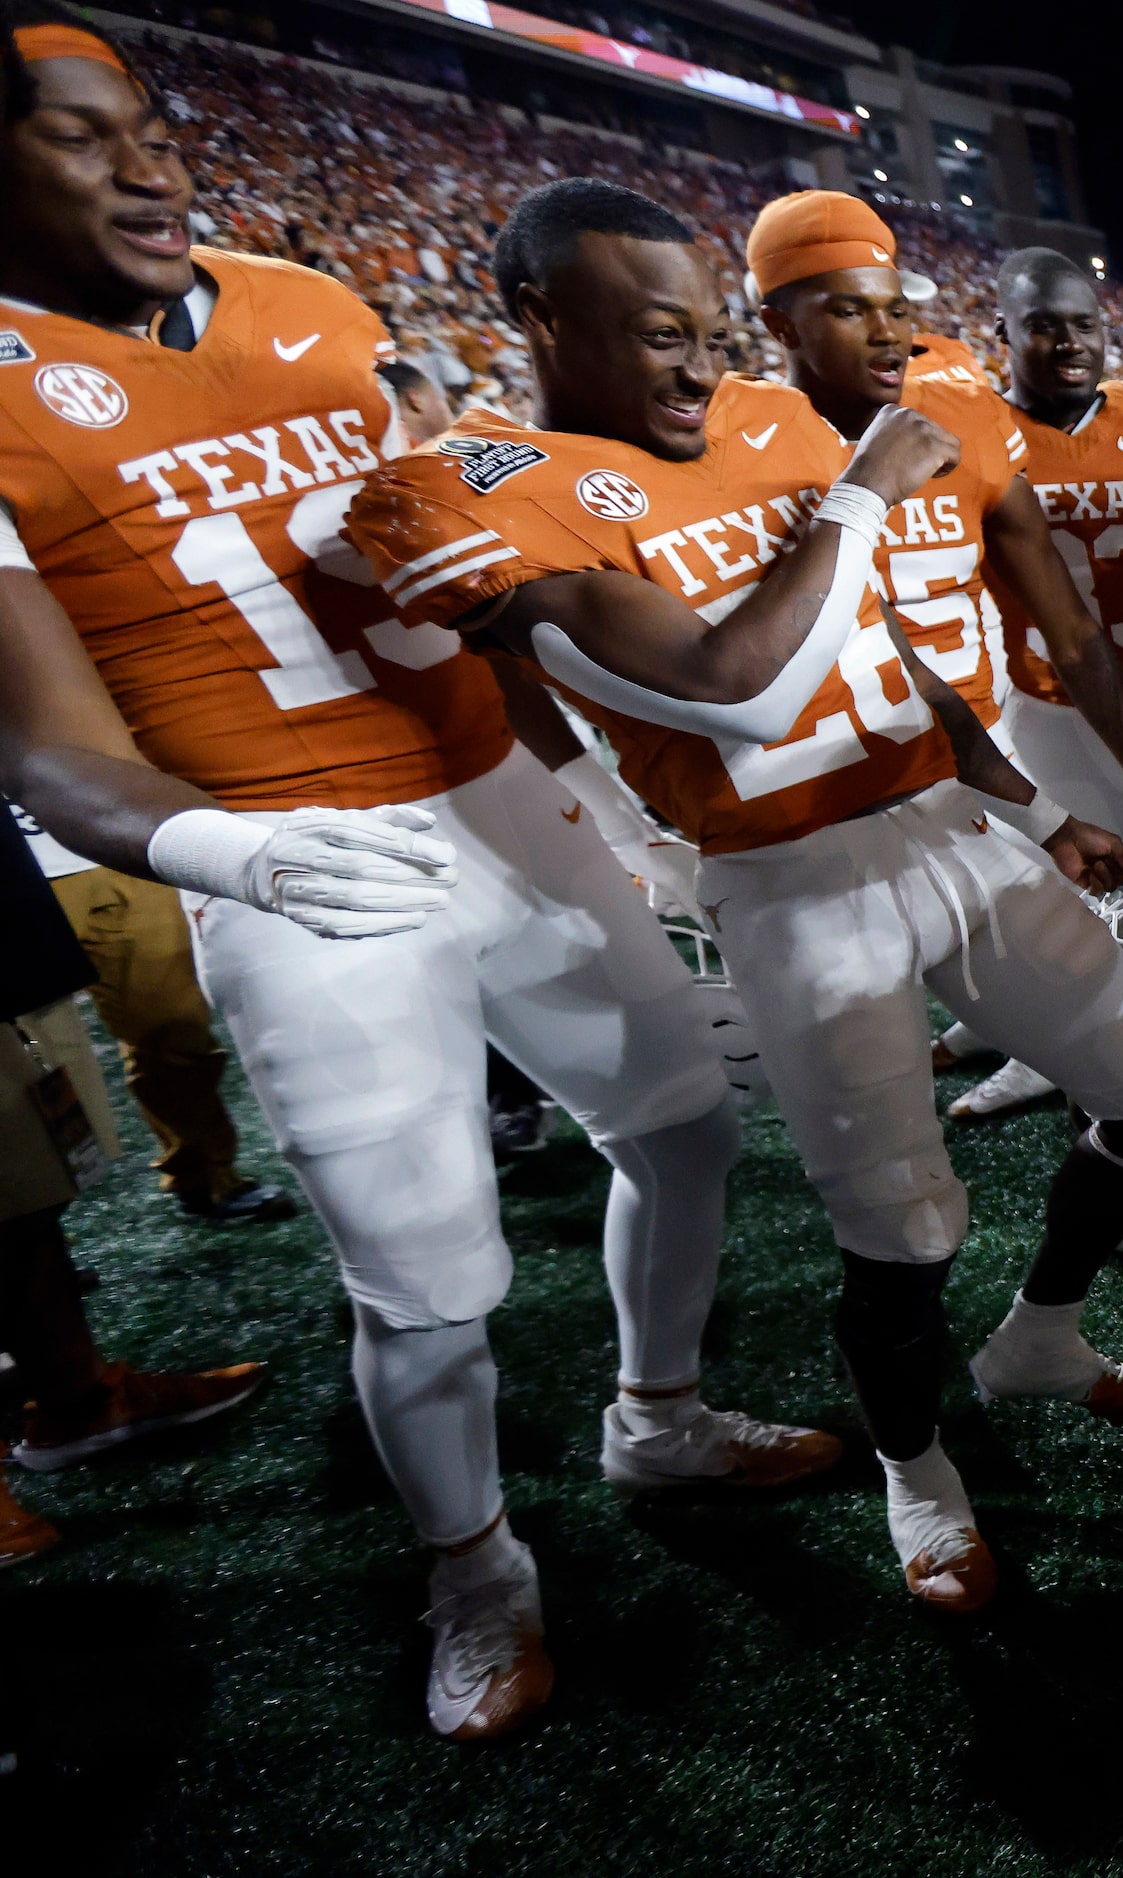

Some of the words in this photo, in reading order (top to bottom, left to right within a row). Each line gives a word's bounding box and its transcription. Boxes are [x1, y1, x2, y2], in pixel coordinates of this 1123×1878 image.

[42, 367, 121, 424] SEC
[118, 410, 379, 518] TEXAS
[583, 472, 642, 518] SEC
[866, 542, 979, 683] 5
